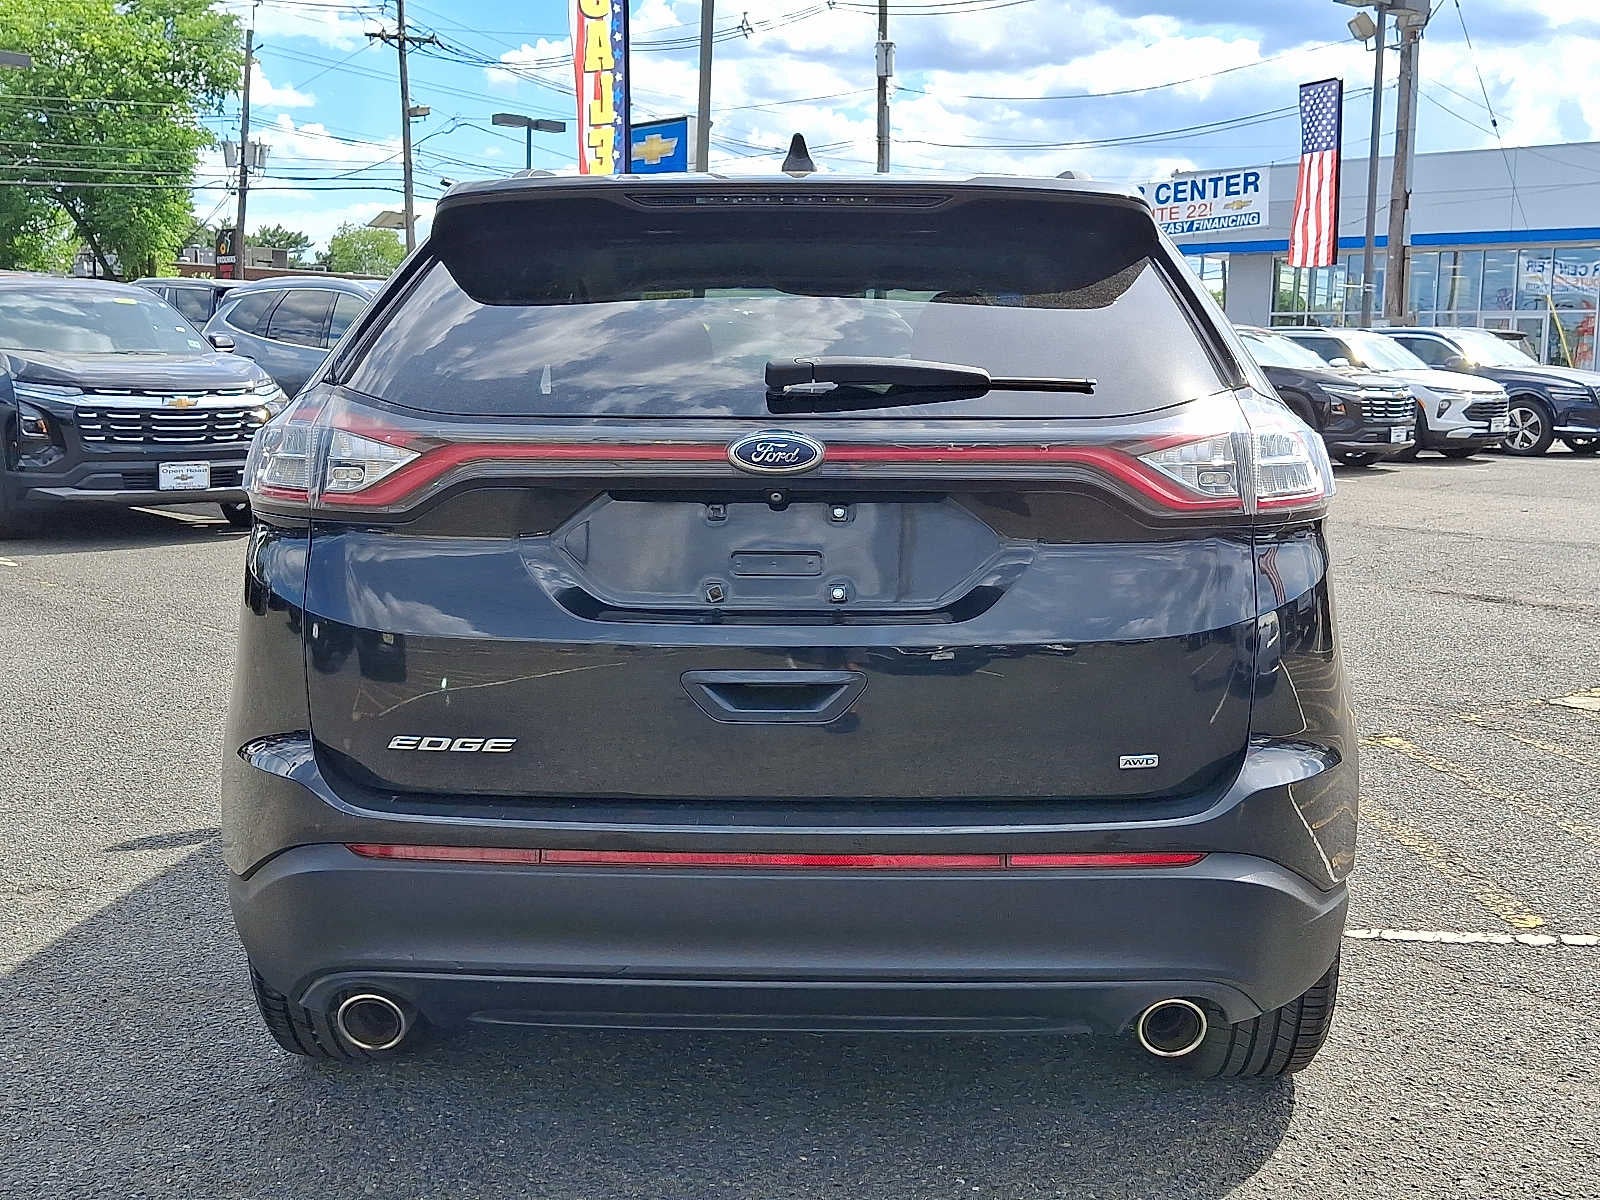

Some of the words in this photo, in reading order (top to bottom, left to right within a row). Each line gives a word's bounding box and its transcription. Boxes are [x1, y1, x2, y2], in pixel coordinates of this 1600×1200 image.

[1155, 171, 1260, 205] CENTER
[1187, 203, 1213, 219] 22!
[1193, 213, 1259, 231] FINANCING
[751, 442, 800, 463] Ford
[387, 735, 517, 753] EDGE
[1122, 758, 1156, 767] AWD
